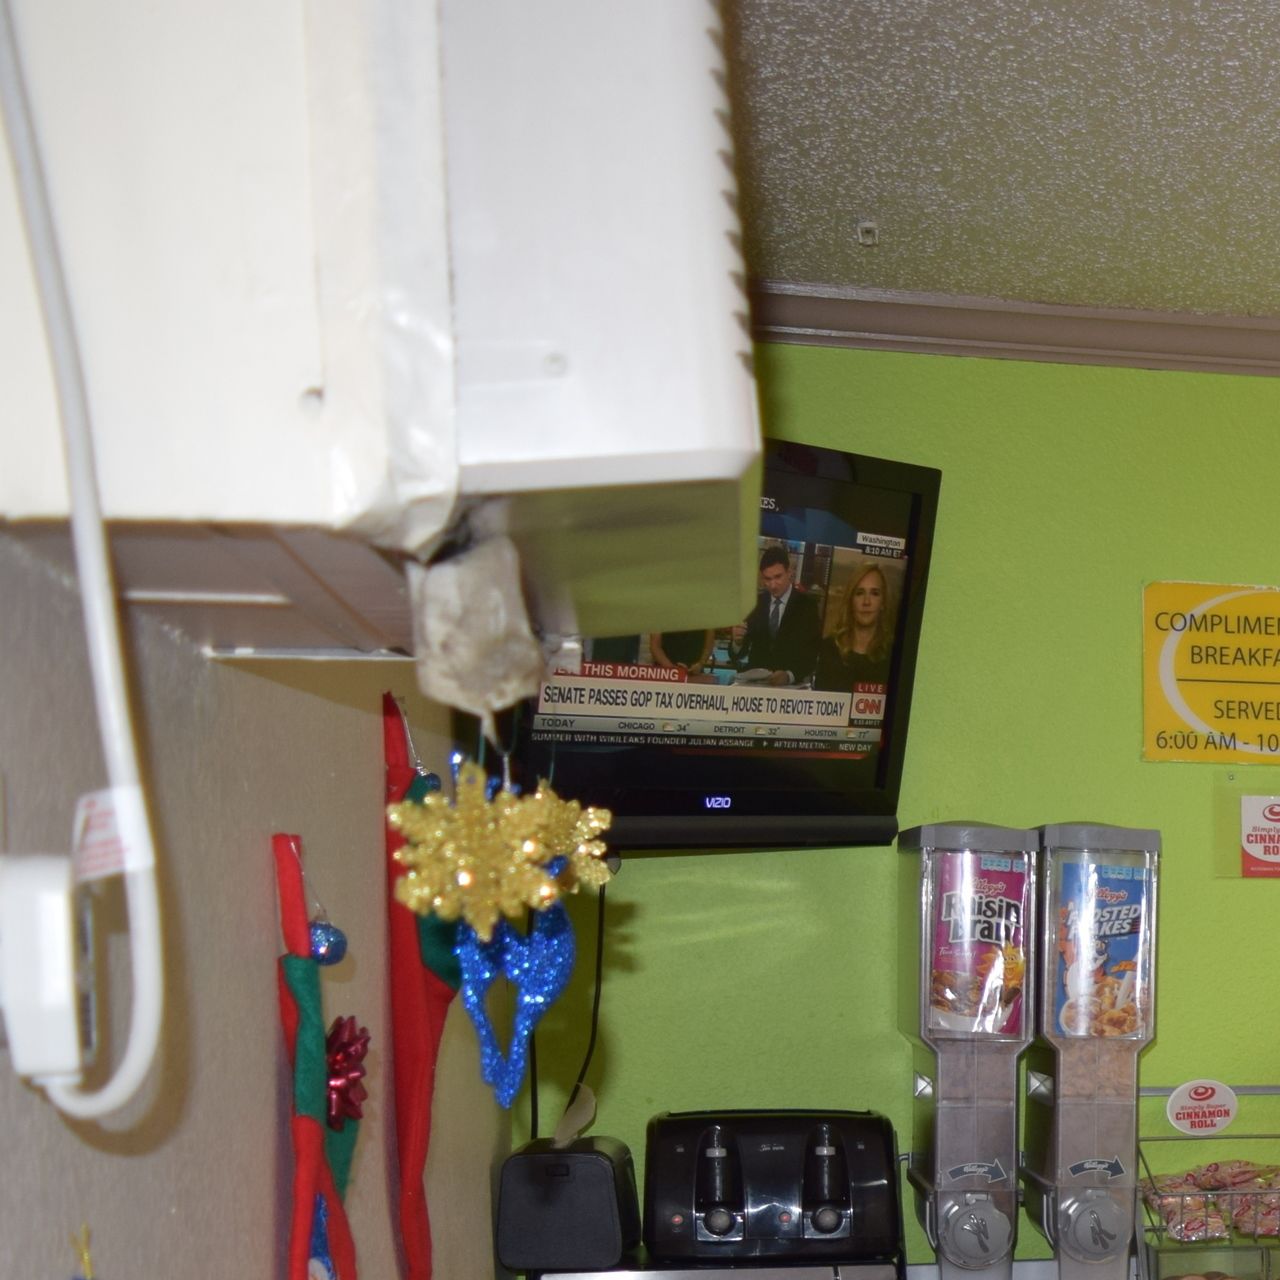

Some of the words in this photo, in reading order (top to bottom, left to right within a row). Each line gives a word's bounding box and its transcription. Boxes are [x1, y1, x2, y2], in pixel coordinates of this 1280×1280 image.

[861, 535, 901, 547] Washington
[880, 548, 892, 556] AM
[584, 663, 613, 676] THIS
[617, 665, 679, 680] MORNING
[857, 683, 884, 693] LIVE
[544, 685, 585, 705] SENATE
[588, 688, 628, 706] PASSES
[630, 690, 652, 708] GOP
[655, 691, 673, 709] TAX
[676, 693, 728, 714] OVERHAUL,
[732, 696, 763, 713] HOUSE
[766, 698, 776, 714] TO
[779, 699, 814, 716] REVOTE
[816, 701, 845, 717] TODAY
[855, 698, 881, 715] CNN
[541, 718, 575, 727] TODAY
[618, 721, 655, 730] CHICAGO
[714, 725, 745, 734] DETROIT
[804, 729, 837, 737] HOUSTON
[574, 735, 596, 743] WITH
[600, 735, 645, 744] WIKILEAKS
[648, 737, 687, 746] FOUNDER
[1156, 731, 1198, 751] 6:00
[1204, 731, 1237, 751] AM
[839, 743, 855, 751] NEW
[857, 743, 872, 752] DAY
[706, 797, 731, 808] VIZIO
[1252, 826, 1280, 834] Simply
[1175, 1108, 1231, 1121] CINNAMON
[1190, 1119, 1217, 1129] ROLL
